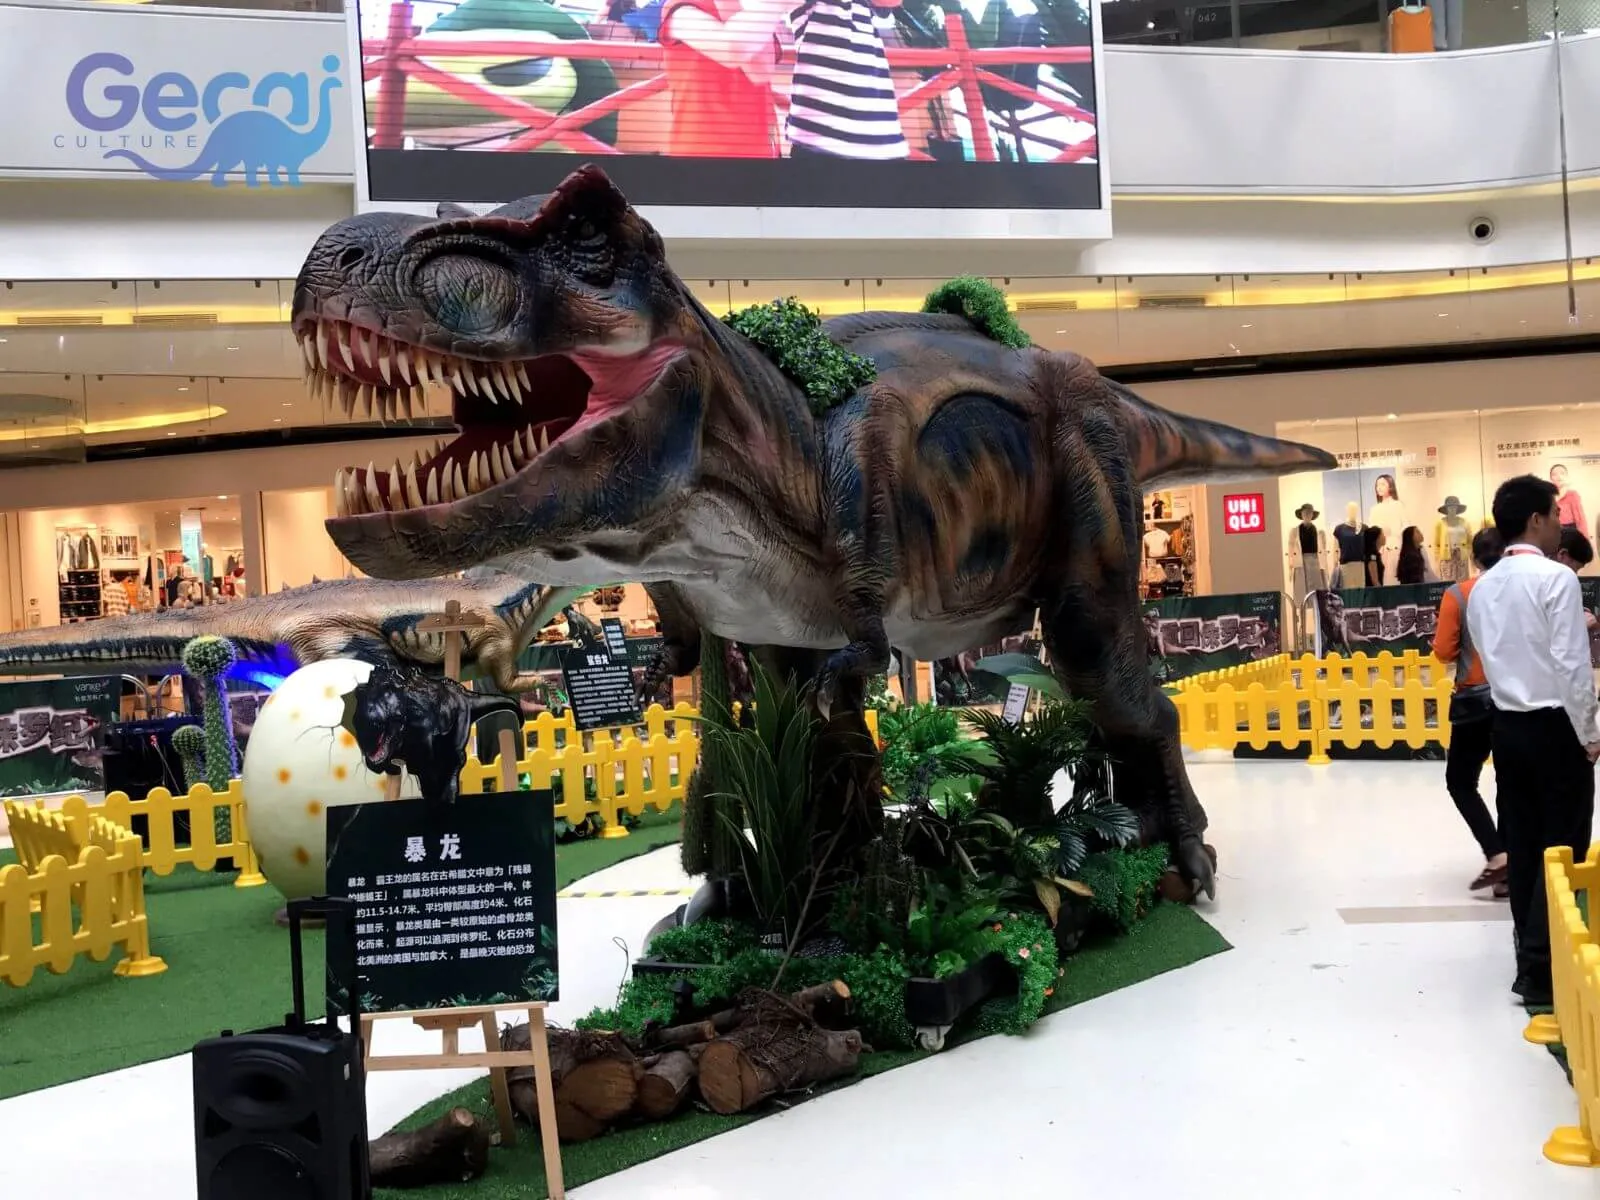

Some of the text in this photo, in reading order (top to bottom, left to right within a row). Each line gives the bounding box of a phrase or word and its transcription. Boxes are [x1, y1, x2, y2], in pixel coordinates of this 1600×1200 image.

[1228, 498, 1258, 513] UNI
[1229, 514, 1261, 531] QLO
[404, 834, 461, 863] 暴龙
